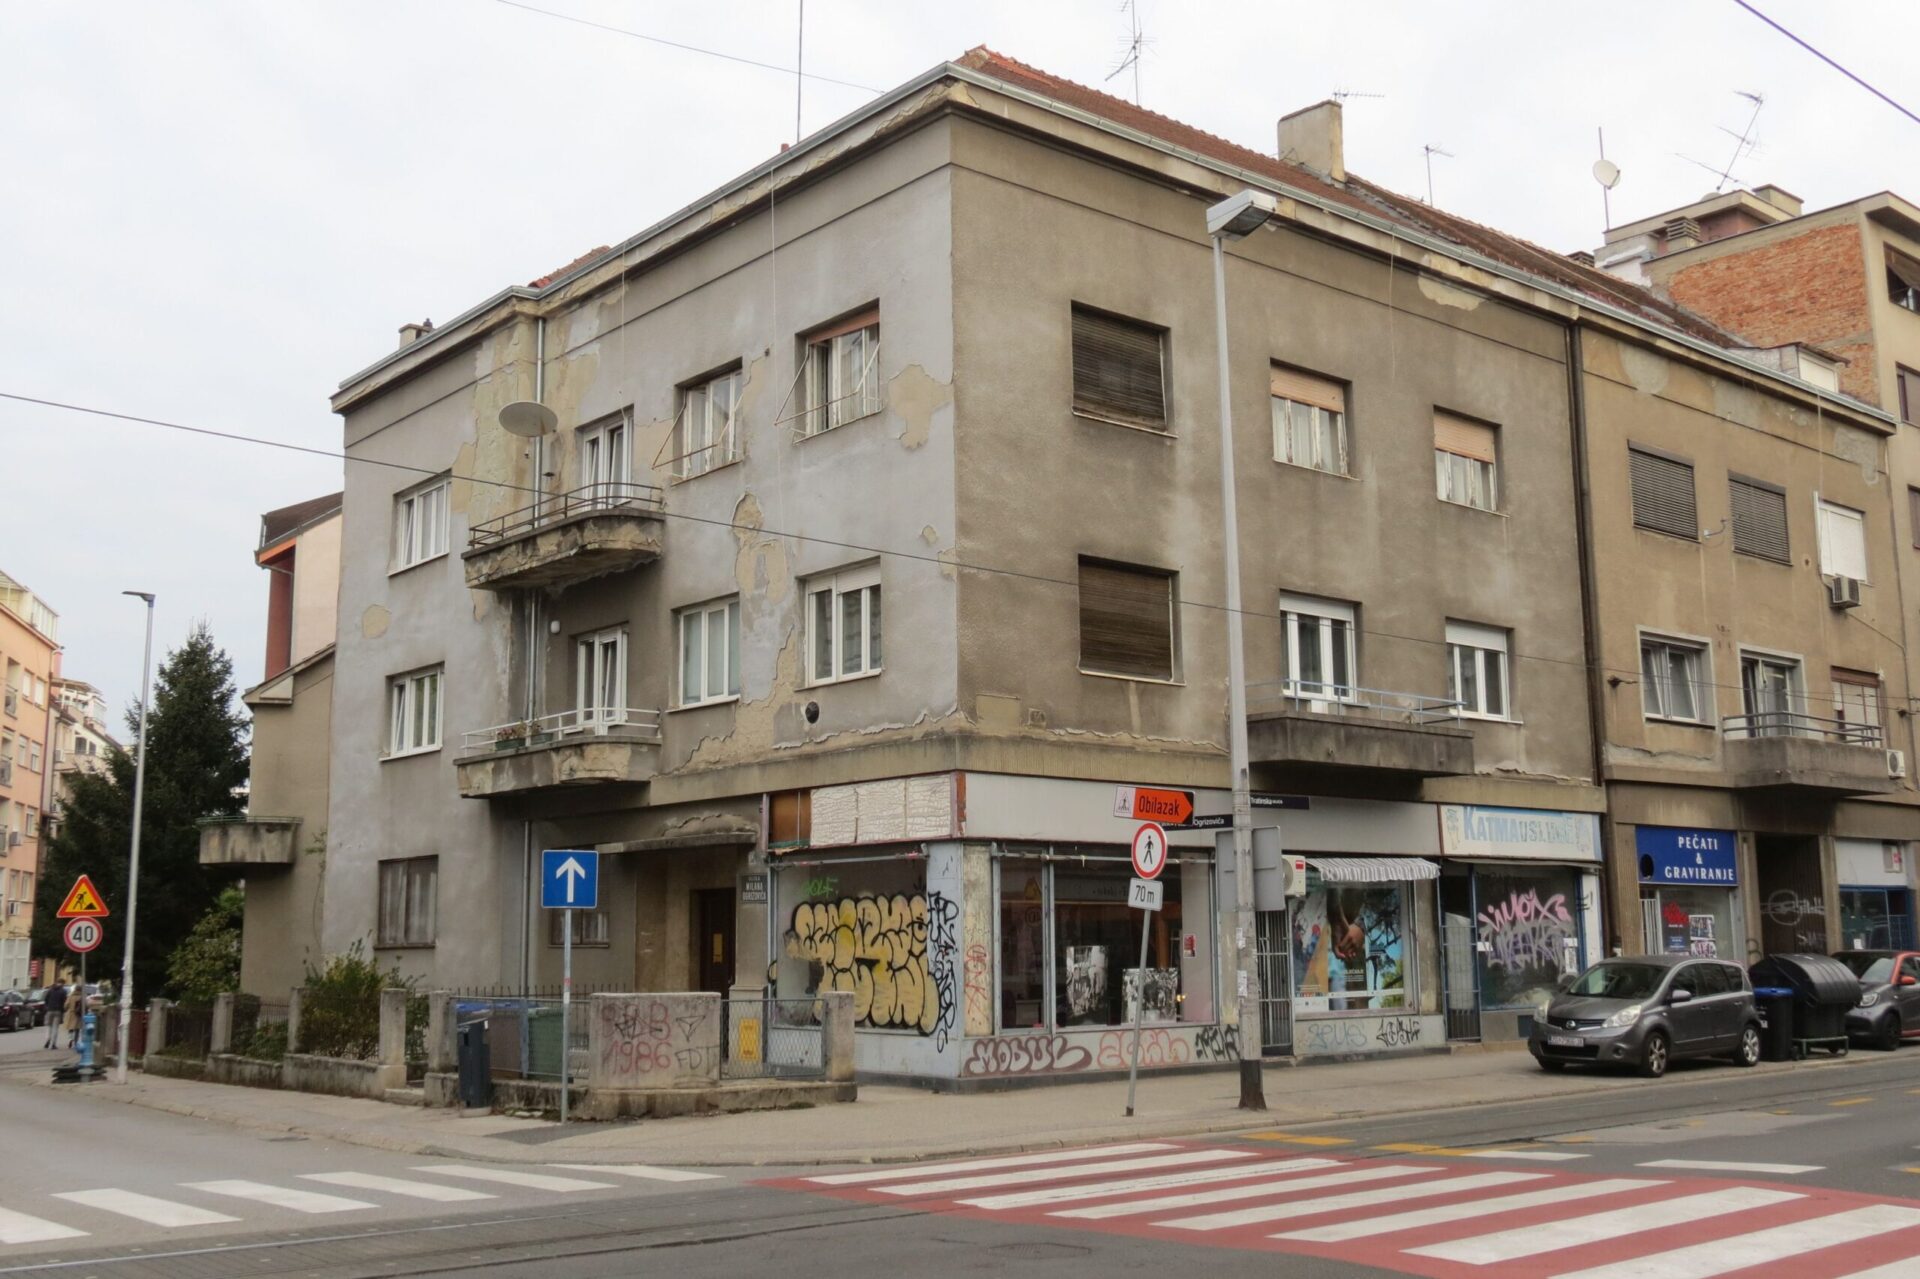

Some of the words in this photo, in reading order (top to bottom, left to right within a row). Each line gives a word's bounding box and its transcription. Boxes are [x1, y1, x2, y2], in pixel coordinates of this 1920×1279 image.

[1138, 795, 1180, 817] Obilazak
[1678, 834, 1718, 850] PEČATI
[1696, 852, 1703, 865] &
[1664, 866, 1734, 880] GRAVIRANJE
[1135, 885, 1146, 902] 70
[73, 926, 94, 943] 40
[601, 1040, 673, 1075] 1986
